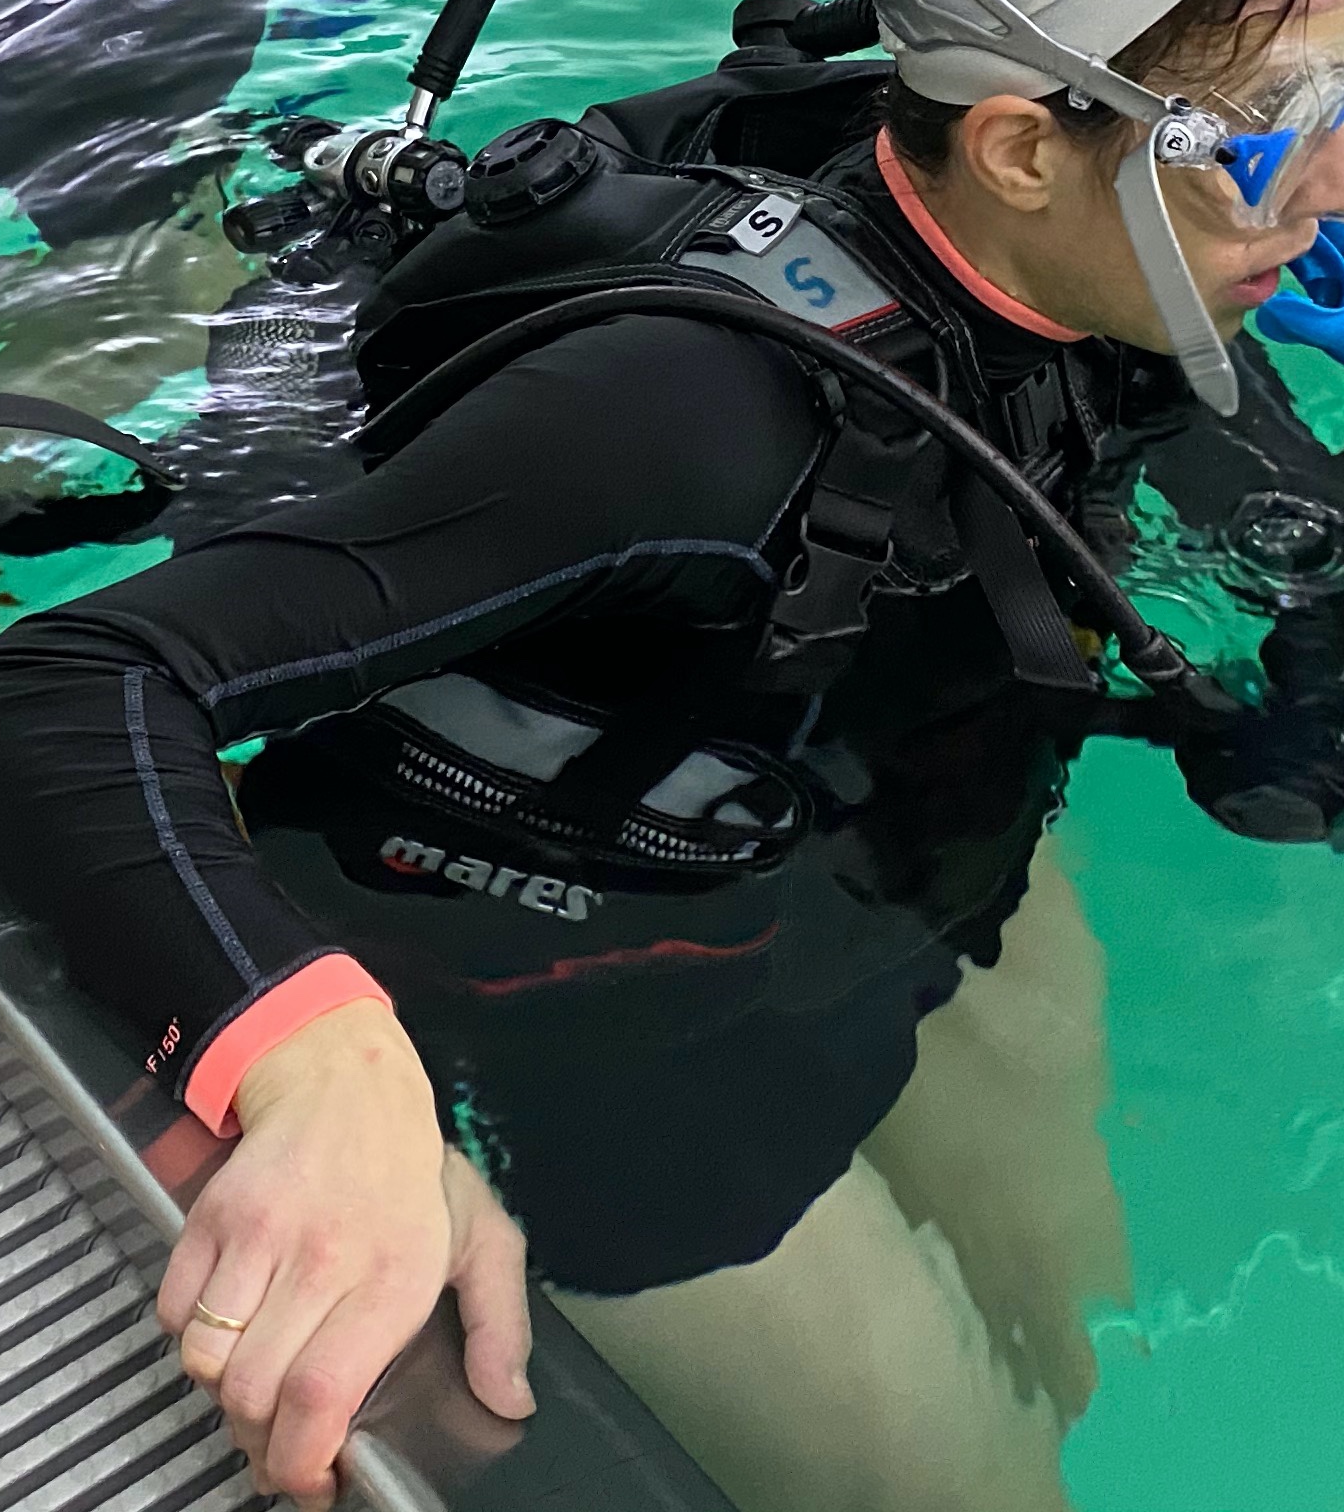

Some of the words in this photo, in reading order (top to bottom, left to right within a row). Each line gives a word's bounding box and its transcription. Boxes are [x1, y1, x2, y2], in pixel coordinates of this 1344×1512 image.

[748, 209, 784, 238] S
[784, 256, 836, 309] S
[379, 836, 603, 921] mares
